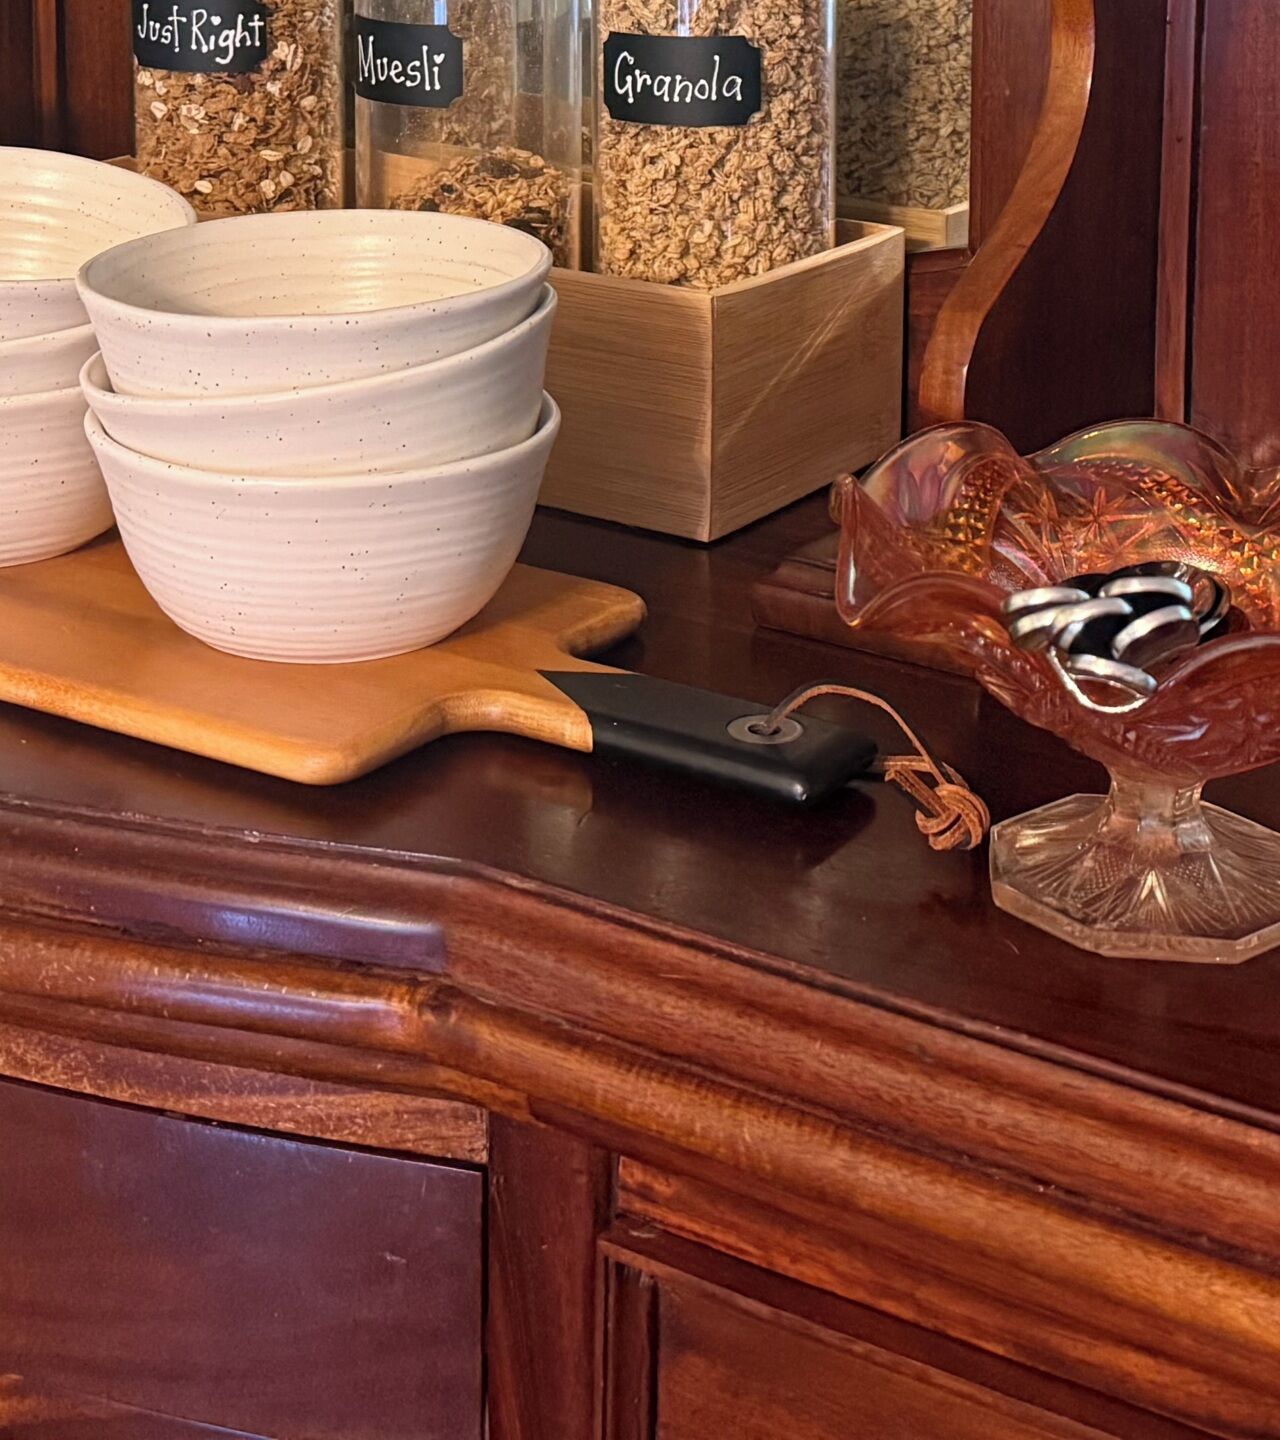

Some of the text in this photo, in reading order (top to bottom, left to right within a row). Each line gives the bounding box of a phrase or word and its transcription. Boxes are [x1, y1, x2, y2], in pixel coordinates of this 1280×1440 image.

[137, 3, 265, 64] Just Right
[357, 34, 446, 92] Muesli
[614, 50, 743, 104] Granola
